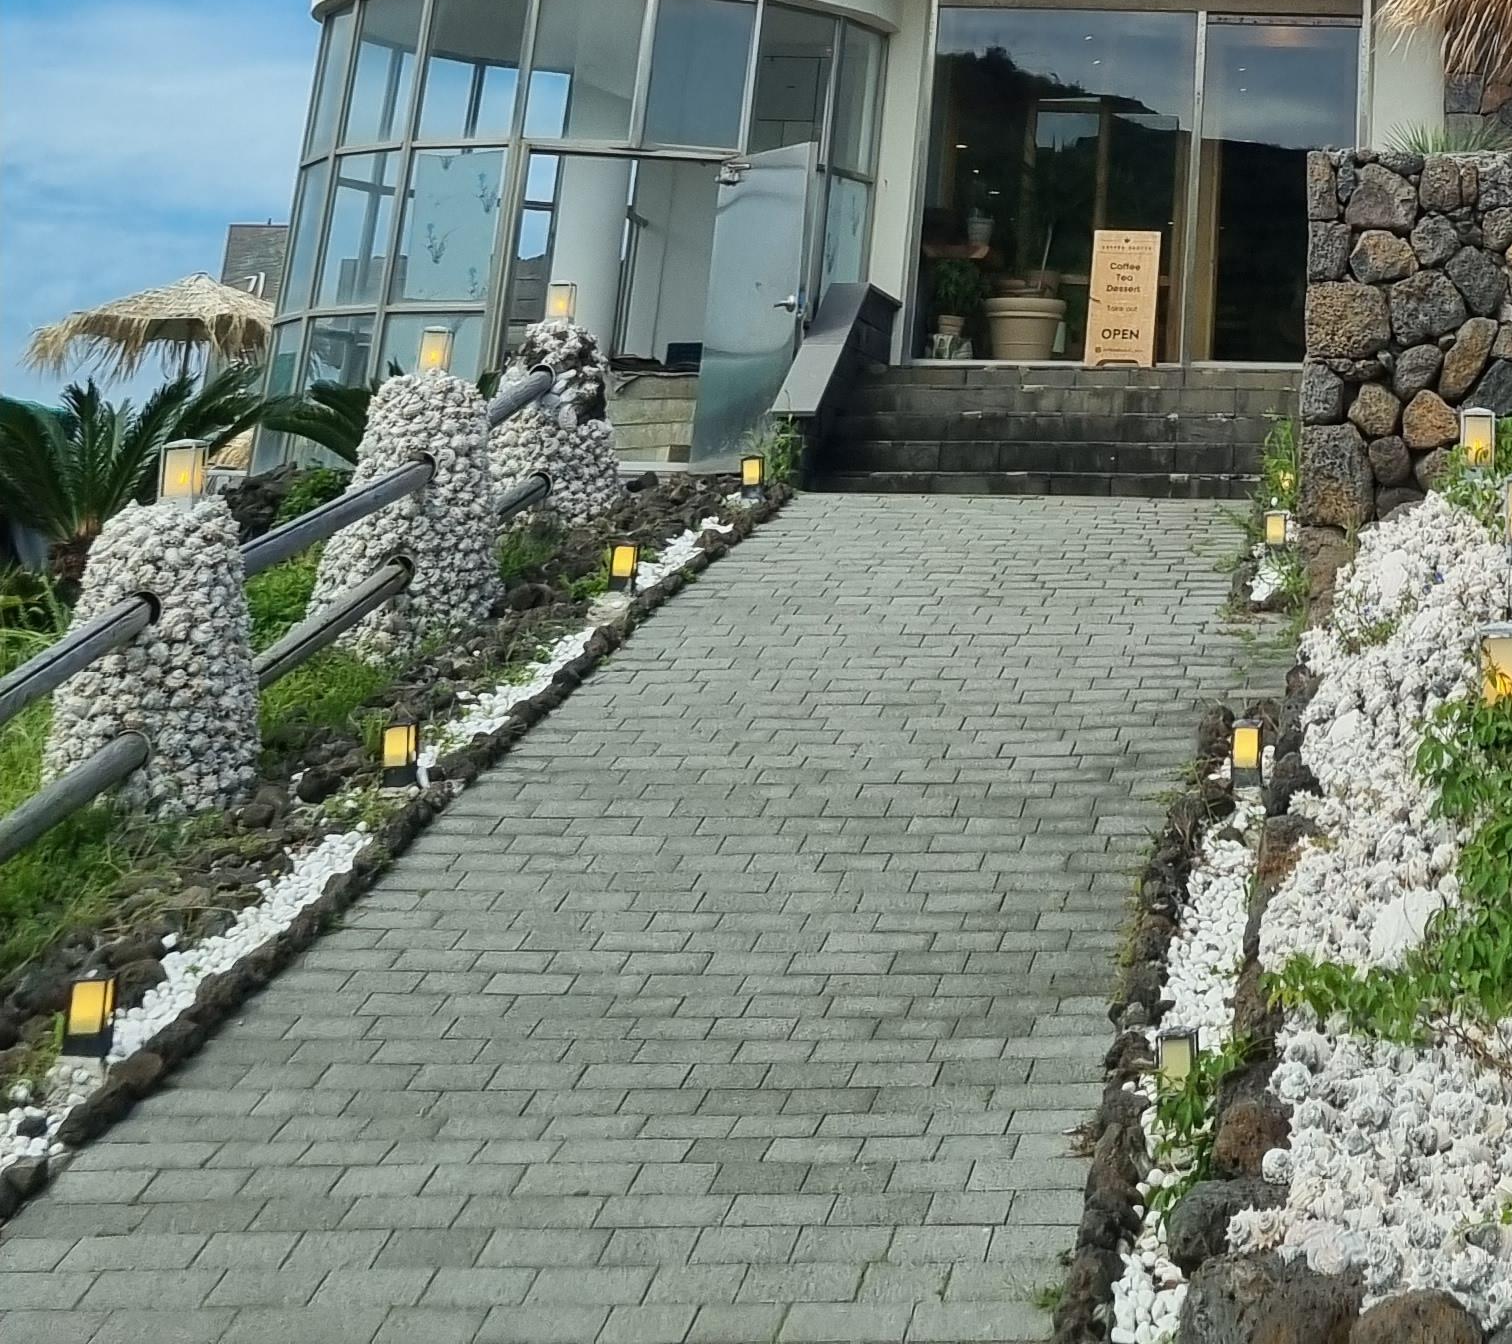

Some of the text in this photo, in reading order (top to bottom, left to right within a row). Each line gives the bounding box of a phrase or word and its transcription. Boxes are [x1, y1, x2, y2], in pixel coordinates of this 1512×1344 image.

[1110, 262, 1141, 271] Coffee
[1116, 273, 1134, 282] Tea
[1106, 284, 1141, 293] Dessert
[1101, 328, 1140, 340] OPEN
